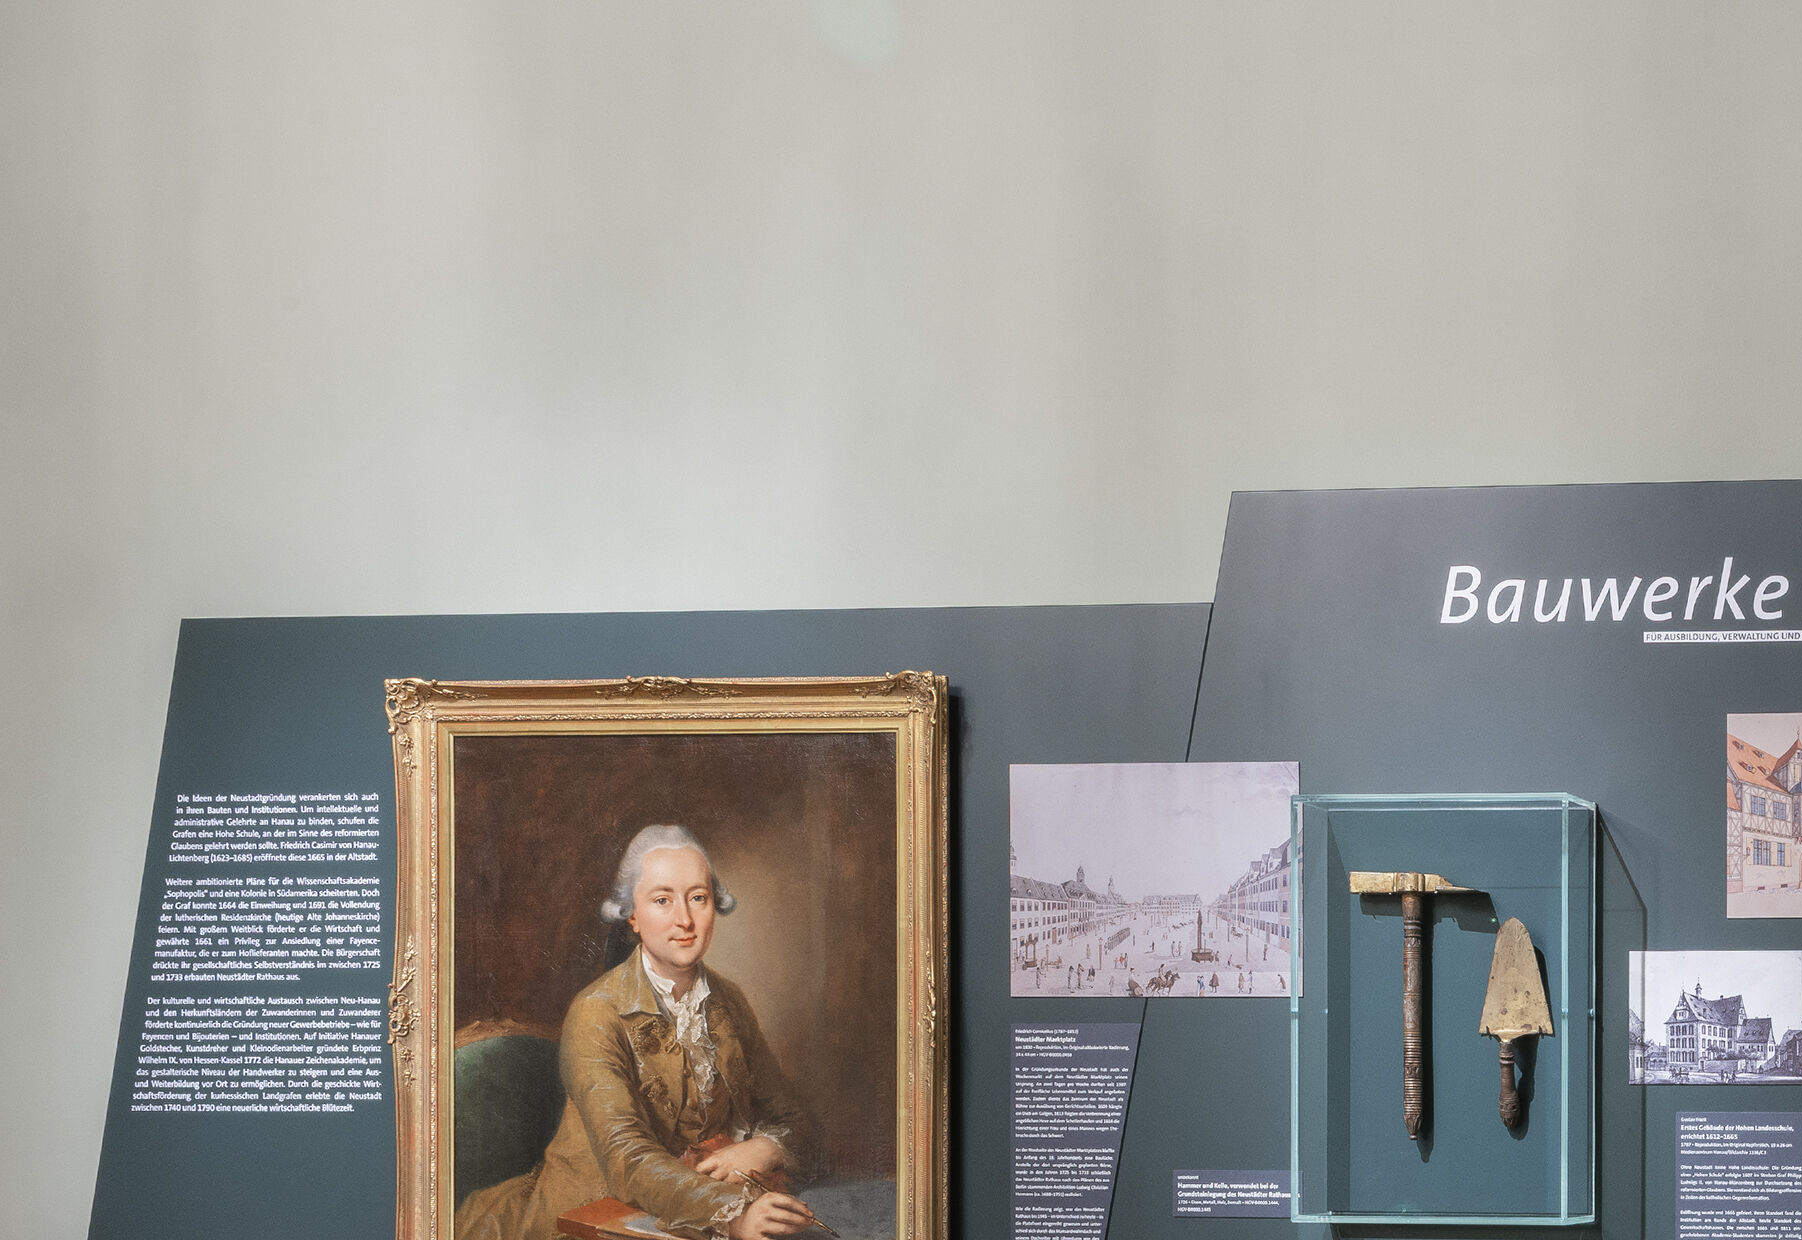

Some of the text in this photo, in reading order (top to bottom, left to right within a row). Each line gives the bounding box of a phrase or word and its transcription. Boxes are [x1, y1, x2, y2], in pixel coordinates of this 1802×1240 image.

[1440, 557, 1790, 624] Bauwerke
[1646, 631, 1661, 641] FÜR
[1722, 632, 1778, 640] VERWALTUNG
[177, 794, 189, 802] Die
[230, 793, 296, 803] Neustadtgründung
[298, 793, 340, 801] verankerten
[344, 792, 358, 800] sich
[361, 792, 378, 800] auch
[186, 806, 204, 814] ihren
[234, 805, 248, 813] und
[251, 805, 297, 813] Institutionen.
[316, 804, 362, 812] intellektuelle
[364, 804, 378, 812] und
[174, 818, 223, 826] administrative
[226, 817, 256, 825] Gelehrte
[308, 817, 334, 825] binden,
[337, 816, 364, 824] schufen
[367, 816, 379, 824] die
[169, 854, 209, 863] Lichtenberg
[210, 853, 252, 862] (1623–1685)
[253, 853, 286, 861] eröffnete
[288, 853, 306, 861] diese
[334, 852, 346, 860] der
[347, 852, 377, 860] Altstadt.
[196, 877, 243, 885] ambitionierte
[246, 877, 265, 885] Pläne
[268, 876, 279, 885] für
[282, 877, 293, 885] die
[296, 876, 379, 885] Wissenschaftsakademie
[216, 972, 255, 980] Neustädter
[131, 1103, 162, 1111] zwischen
[182, 1103, 196, 1111] und
[215, 1103, 230, 1111] eine
[232, 1103, 267, 1111] neuerliche
[269, 1103, 320, 1111] wirtschaftliche
[321, 1103, 354, 1111] Blütezeit.
